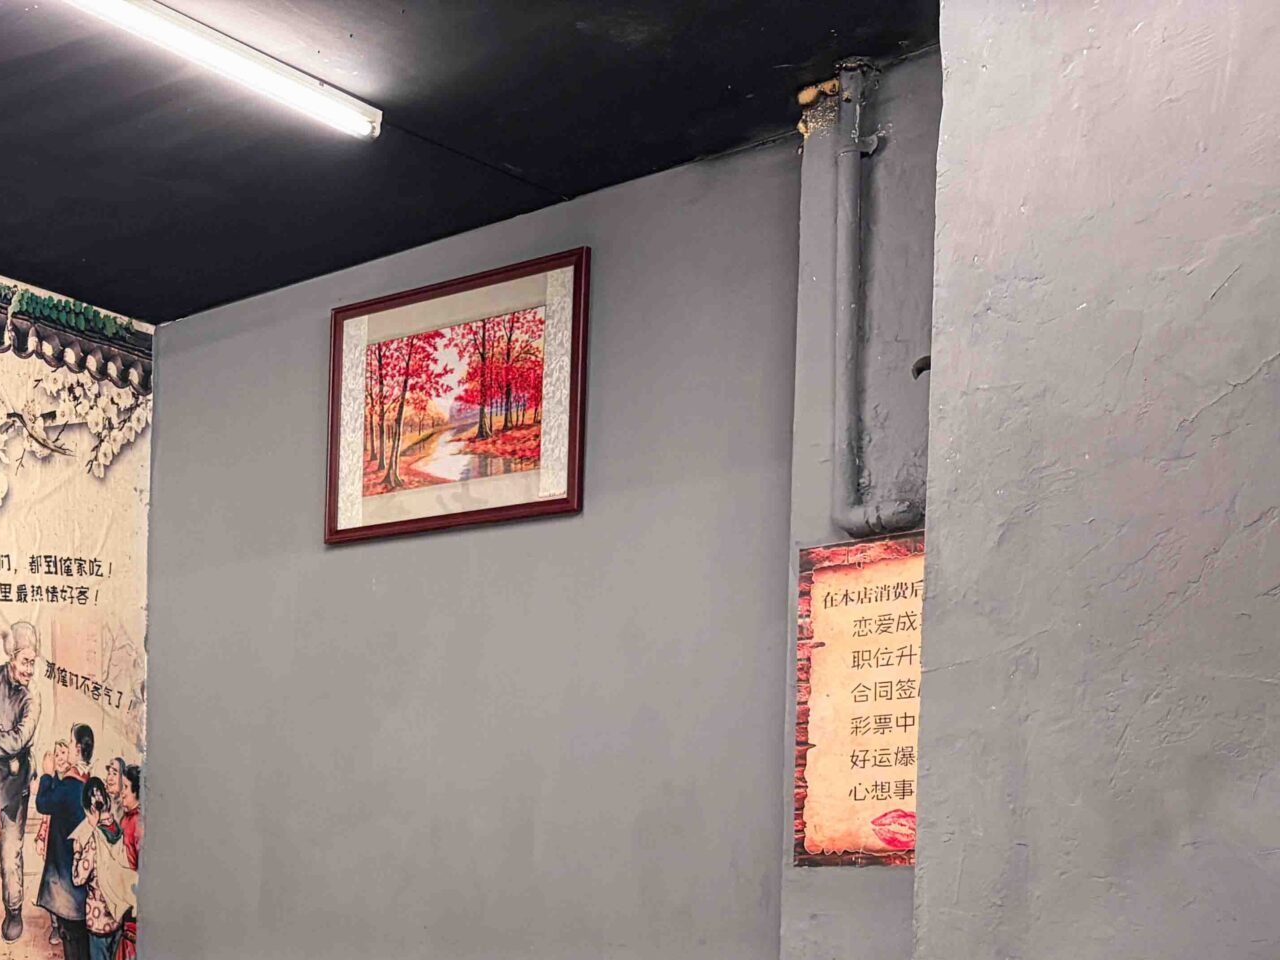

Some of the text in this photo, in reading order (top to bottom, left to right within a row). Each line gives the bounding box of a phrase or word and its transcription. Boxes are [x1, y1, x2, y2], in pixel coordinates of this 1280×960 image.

[852, 610, 921, 638] 恋爱成
[851, 644, 921, 670] 职位升
[851, 678, 920, 703] 合同签
[850, 712, 915, 736] 彩票中
[850, 746, 916, 770] 好运爆
[848, 779, 915, 801] 心想事
